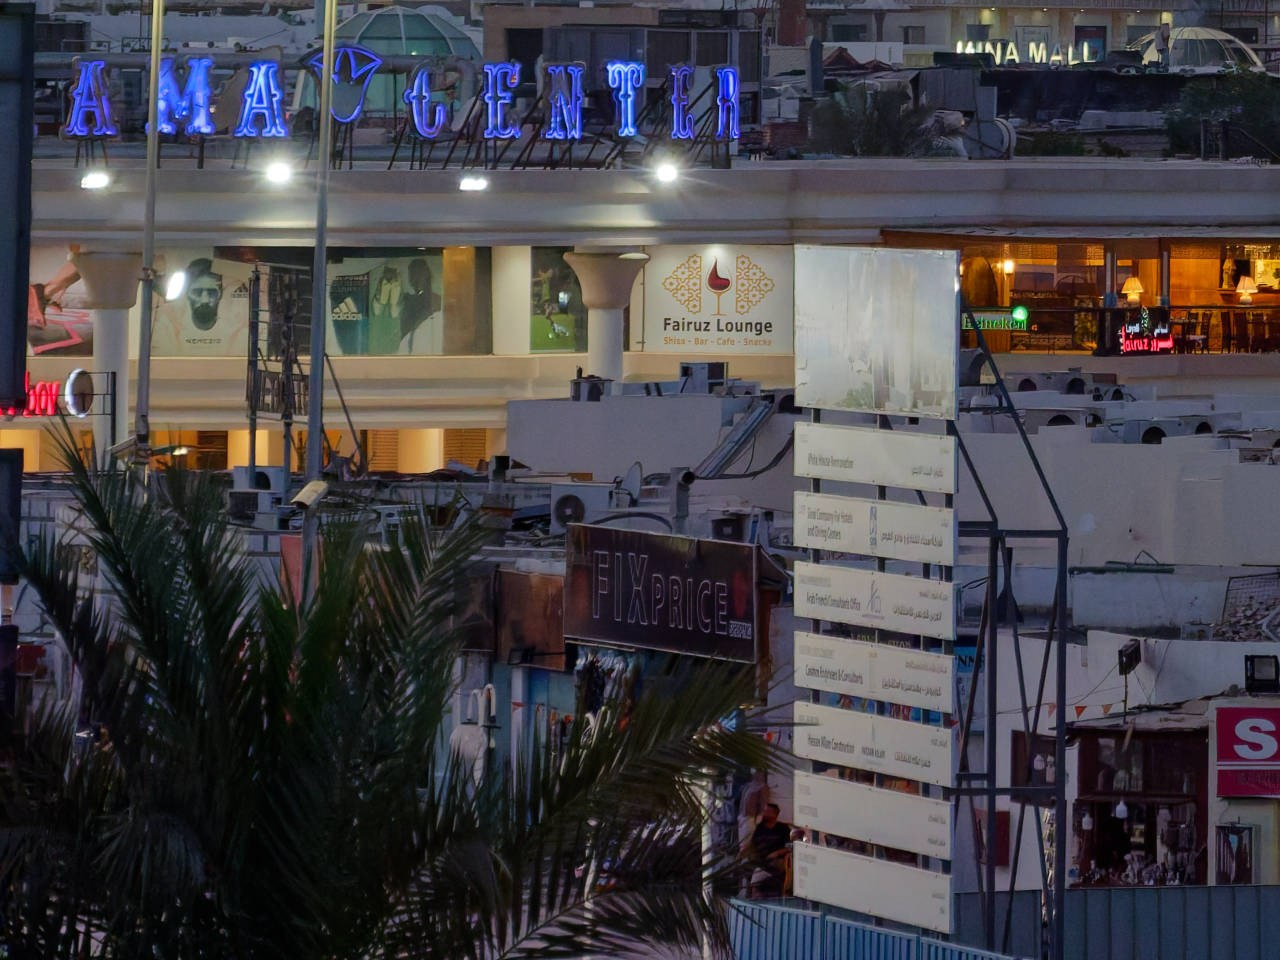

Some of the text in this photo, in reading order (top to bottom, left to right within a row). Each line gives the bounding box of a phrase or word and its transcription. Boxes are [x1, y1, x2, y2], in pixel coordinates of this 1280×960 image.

[1028, 41, 1097, 66] MALL
[34, 56, 742, 141] AMA CENTER
[663, 317, 773, 336] Fairuz Lounge
[694, 337, 708, 345] Bar
[592, 549, 728, 636] FIX PRICE
